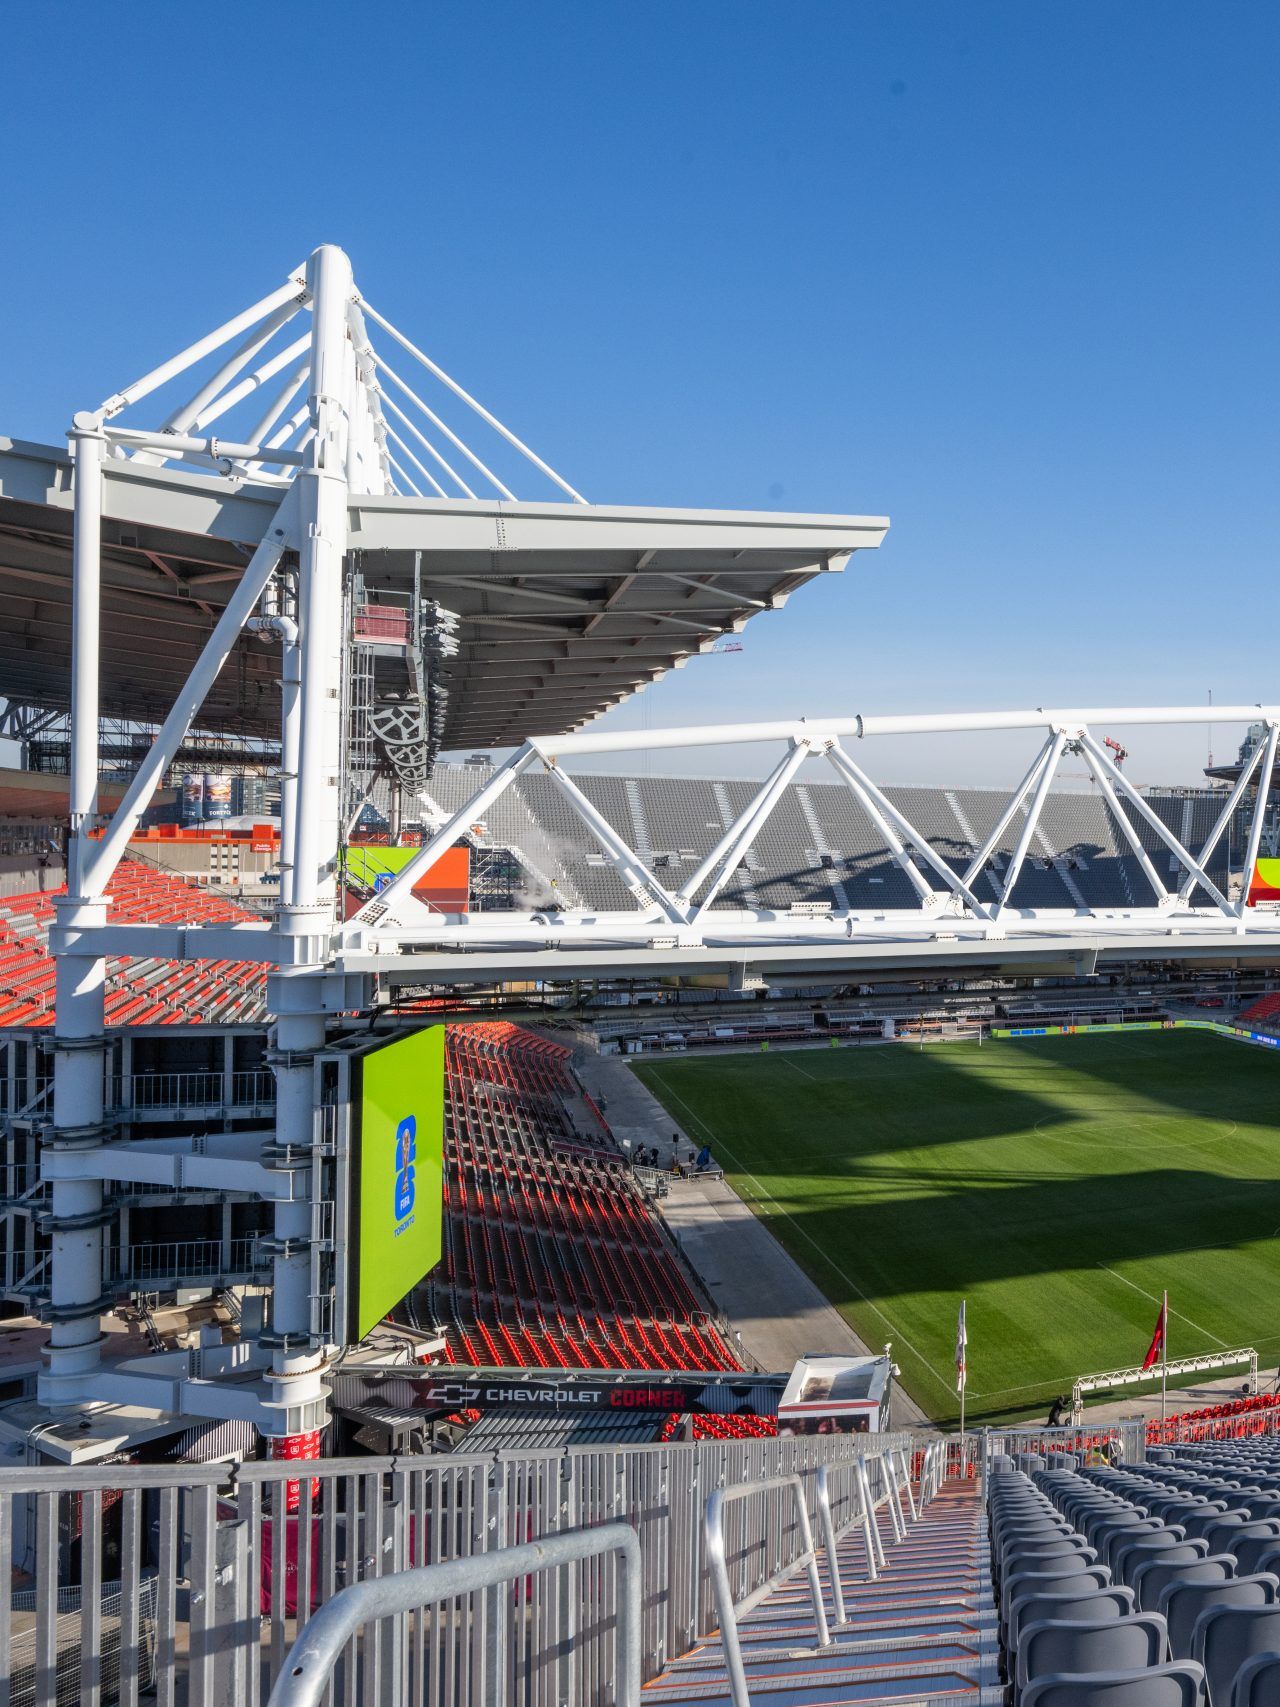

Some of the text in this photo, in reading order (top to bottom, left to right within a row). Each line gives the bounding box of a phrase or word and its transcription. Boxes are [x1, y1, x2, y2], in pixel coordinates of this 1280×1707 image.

[400, 1195, 410, 1211] FIFA
[394, 1214, 415, 1238] TORONTO
[486, 1389, 686, 1408] CHEVROLET CORNER
